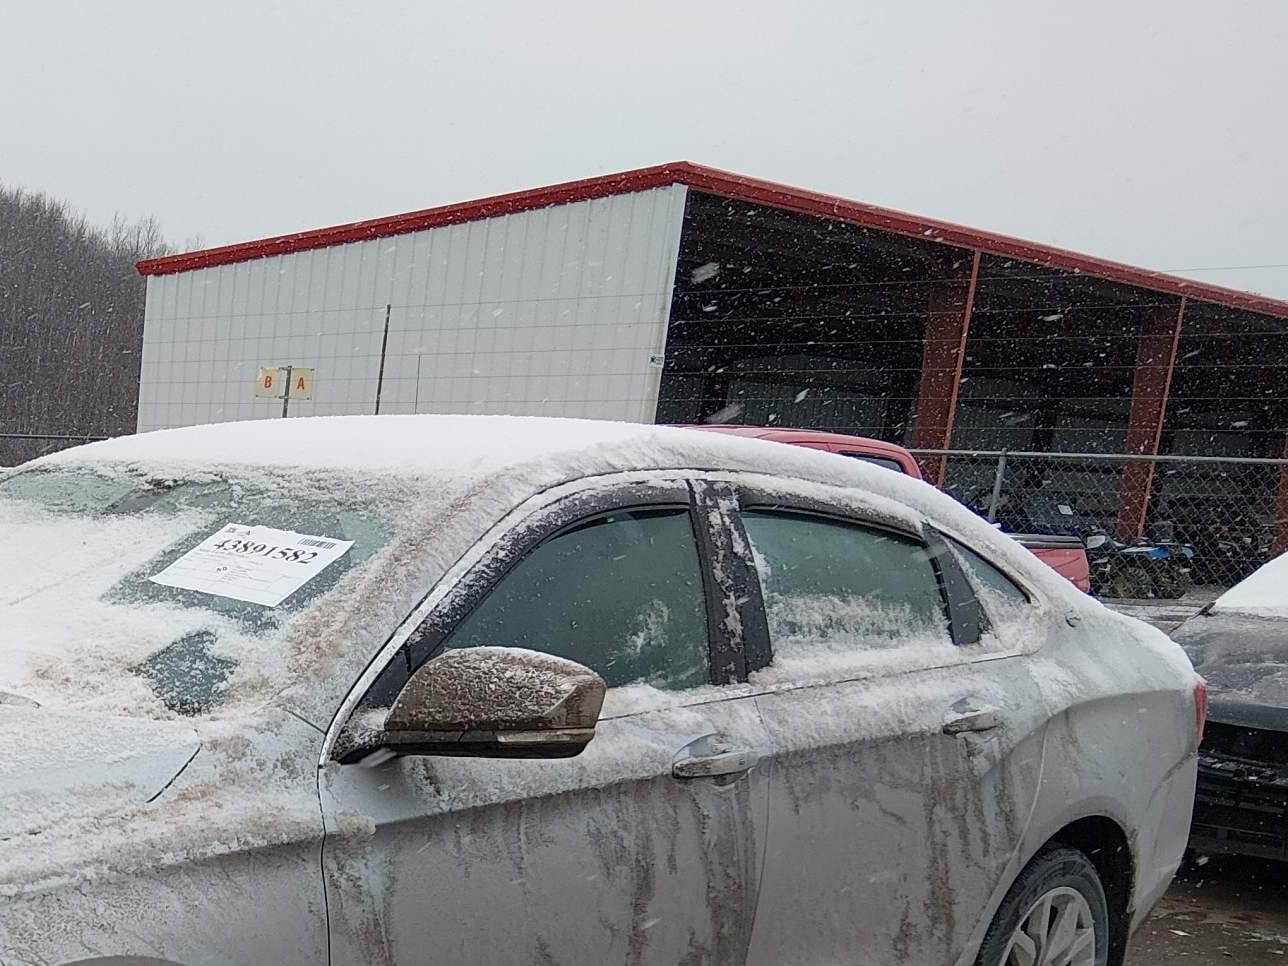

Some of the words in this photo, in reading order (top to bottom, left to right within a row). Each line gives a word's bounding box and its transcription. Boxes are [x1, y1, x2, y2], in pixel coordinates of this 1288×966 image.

[264, 376, 272, 388] B
[297, 377, 305, 389] A
[214, 540, 317, 564] 43891582
